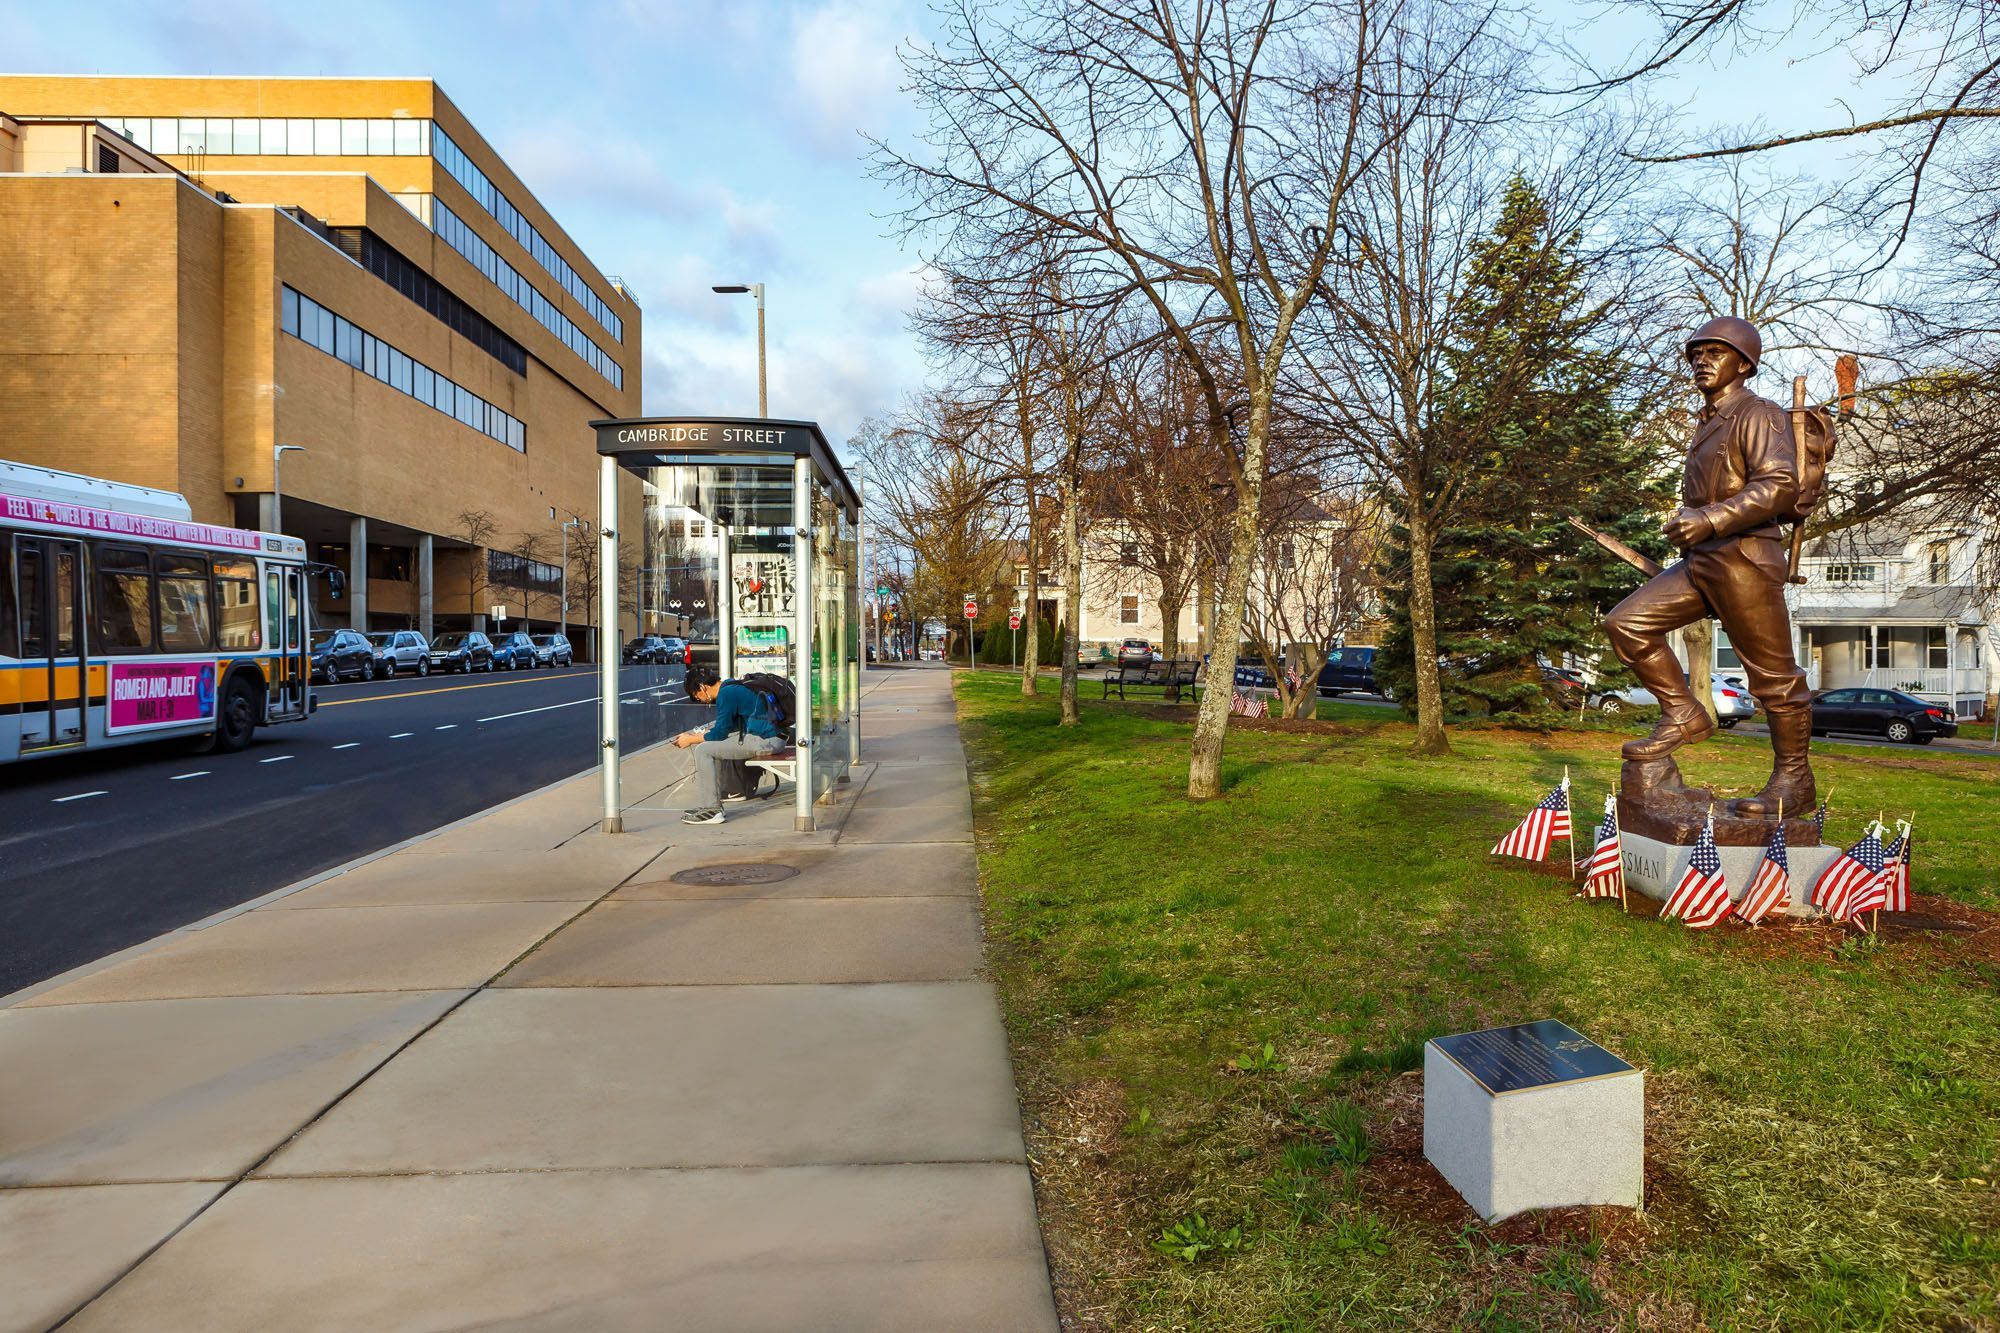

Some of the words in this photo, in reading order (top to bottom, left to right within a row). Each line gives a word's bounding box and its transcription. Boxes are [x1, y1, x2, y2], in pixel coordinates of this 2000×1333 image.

[618, 428, 709, 443] CAMBRIDGE
[723, 429, 786, 444] STREET
[7, 497, 30, 518] FEEL
[29, 501, 48, 520] THE
[49, 504, 80, 525] POWER
[81, 509, 92, 526] OF
[93, 510, 108, 529] THE
[108, 512, 141, 534] WORLD'S
[142, 519, 174, 538] GREATEST
[734, 577, 796, 594] YORK
[739, 594, 794, 612] CITY
[115, 678, 148, 700] ROMEO
[148, 677, 167, 698] AND
[168, 676, 196, 697] JULIET
